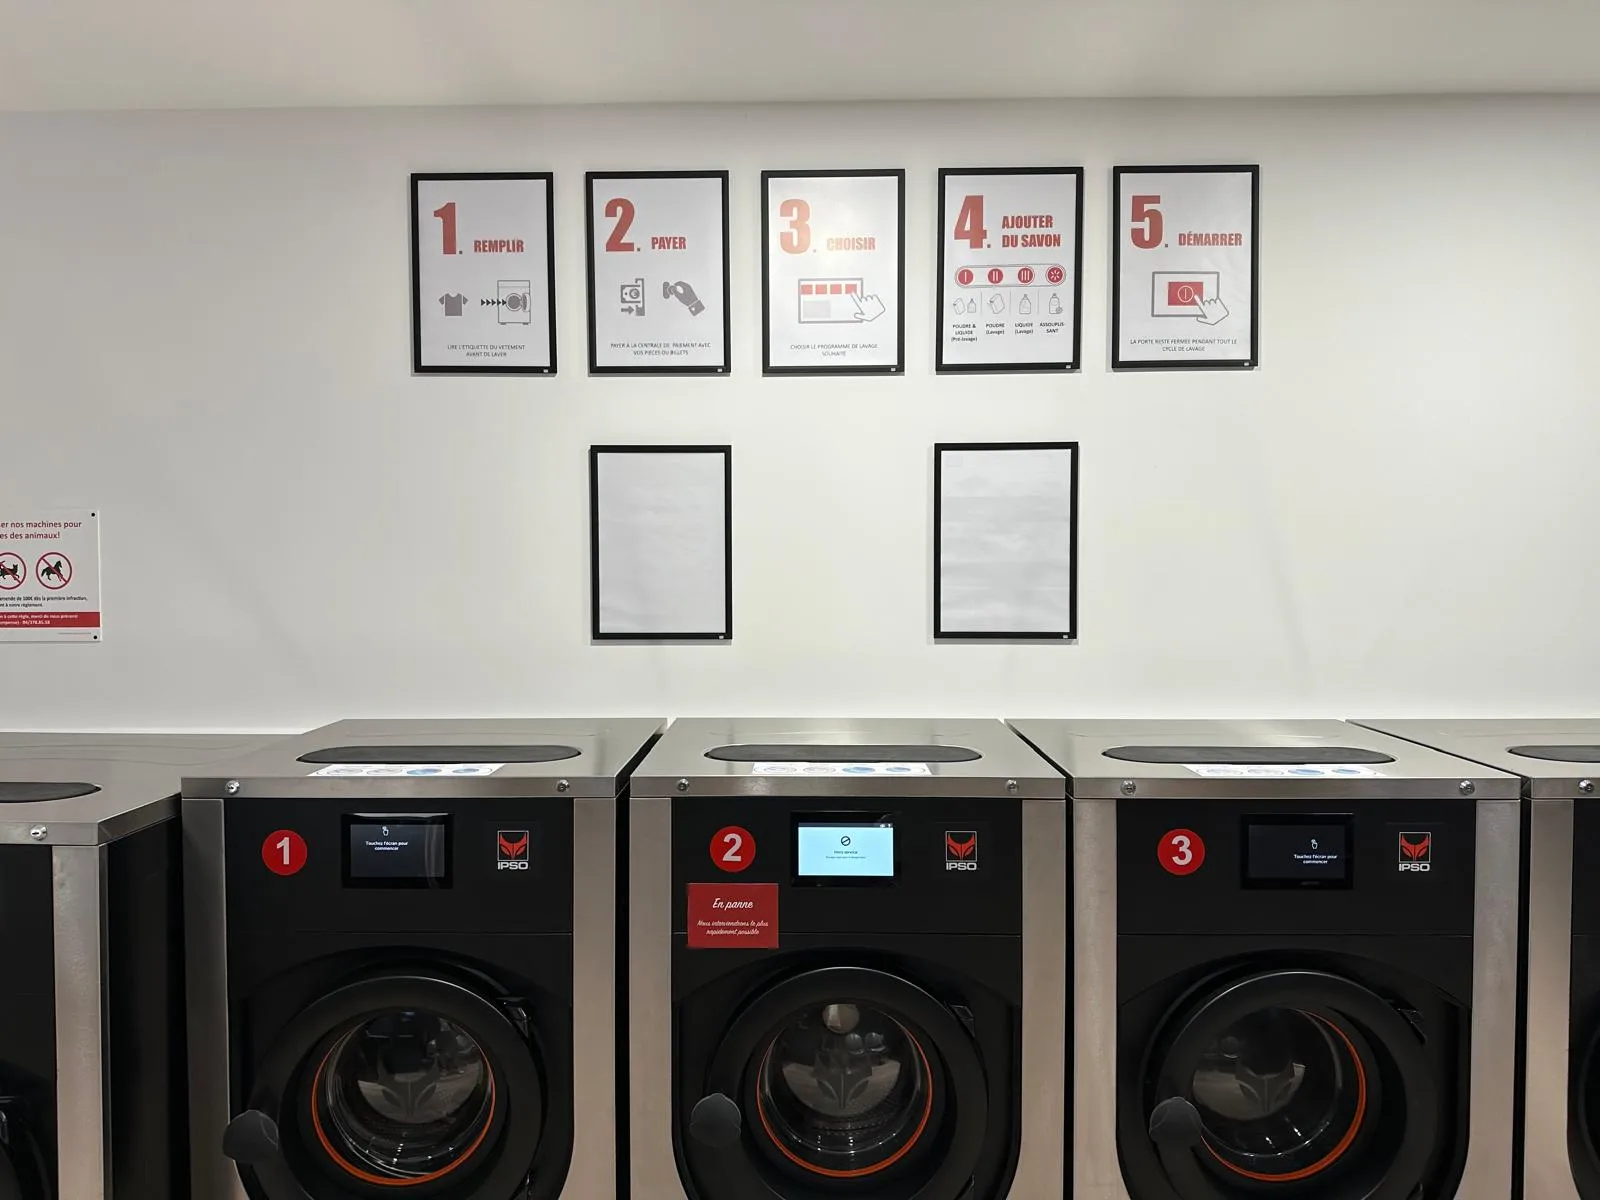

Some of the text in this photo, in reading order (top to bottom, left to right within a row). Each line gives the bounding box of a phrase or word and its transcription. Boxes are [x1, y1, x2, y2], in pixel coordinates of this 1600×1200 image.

[434, 202, 524, 254] 1. REMPLIR
[604, 198, 687, 252] 2. PAYER
[780, 198, 876, 255] 3. CHOISIR
[954, 195, 991, 249] 4.
[1002, 215, 1054, 229] AJOUTER
[1130, 195, 1243, 249] 5. DÉMARRER
[1002, 234, 1061, 248] DU SAVON
[276, 837, 290, 865] 1
[722, 833, 742, 862] 2
[1171, 835, 1193, 866] 3
[498, 862, 528, 870] IPSO
[946, 862, 977, 870] IPSO
[1399, 863, 1430, 872] IPSO
[712, 898, 754, 910] En panne
